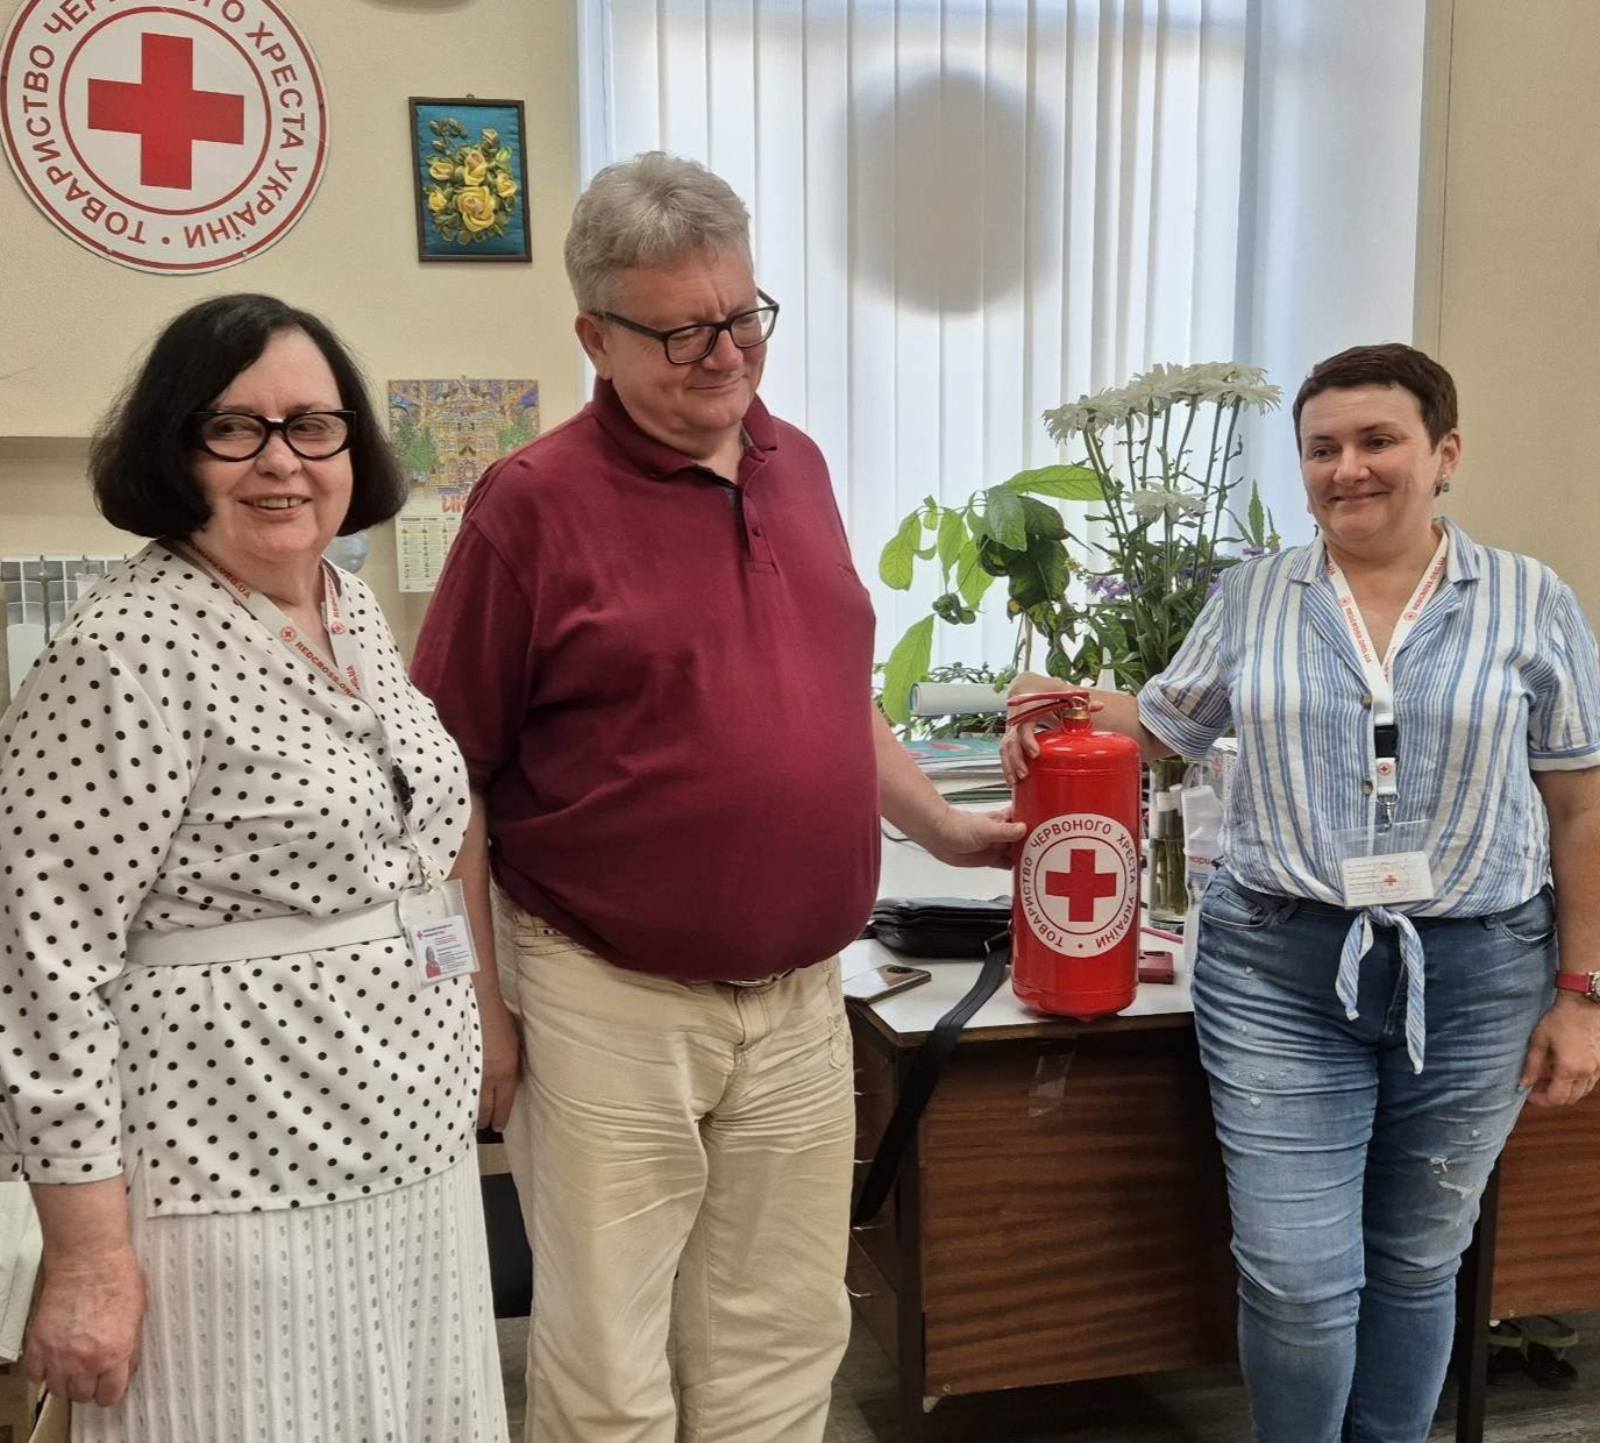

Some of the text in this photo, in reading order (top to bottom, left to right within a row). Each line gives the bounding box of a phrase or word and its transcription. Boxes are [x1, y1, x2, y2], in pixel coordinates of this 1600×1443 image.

[23, 21, 305, 249] ТОВАРИСТВО ХРЕСТА УКРАЇНИ
[1022, 819, 1137, 949] ТОВАРИСТВО ЧЕРВОНОГО ХРЕСТА УКРАЇНИ
